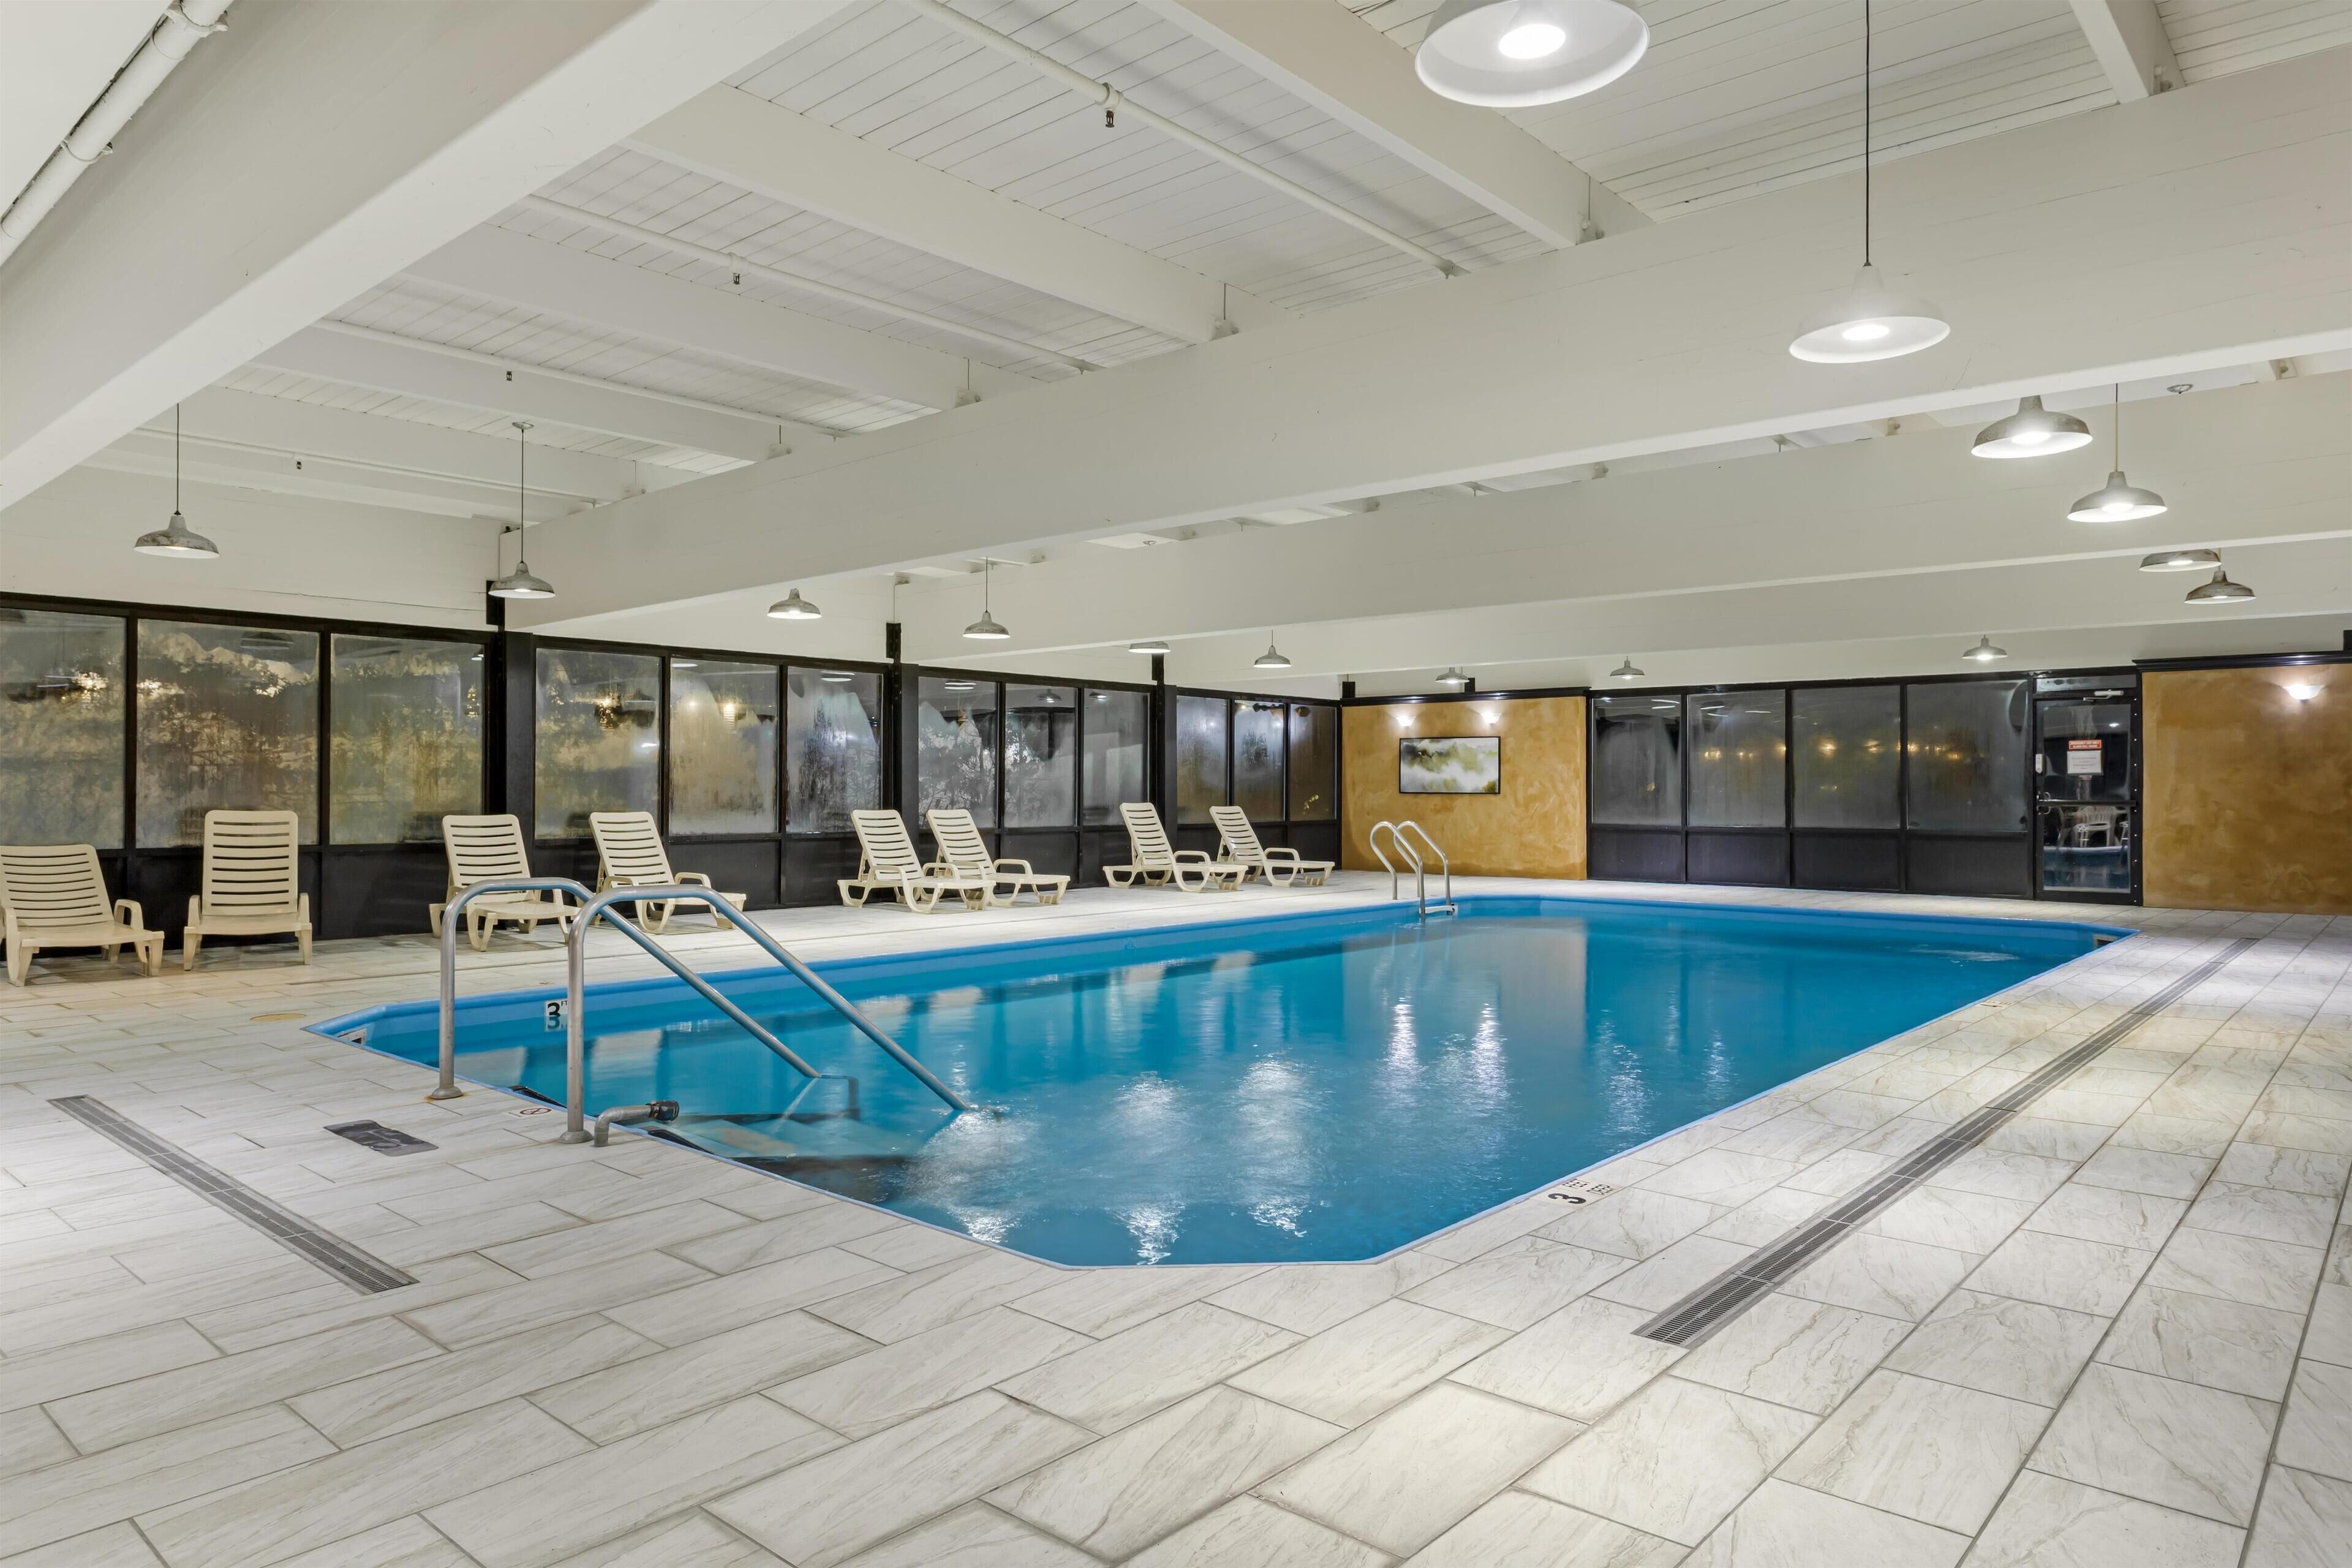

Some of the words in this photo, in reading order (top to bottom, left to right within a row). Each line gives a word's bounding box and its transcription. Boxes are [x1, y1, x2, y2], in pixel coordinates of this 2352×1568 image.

[1562, 1178, 1590, 1189] FEET
[1586, 1184, 1613, 1196] DEEP
[1548, 1193, 1586, 1204] 3
